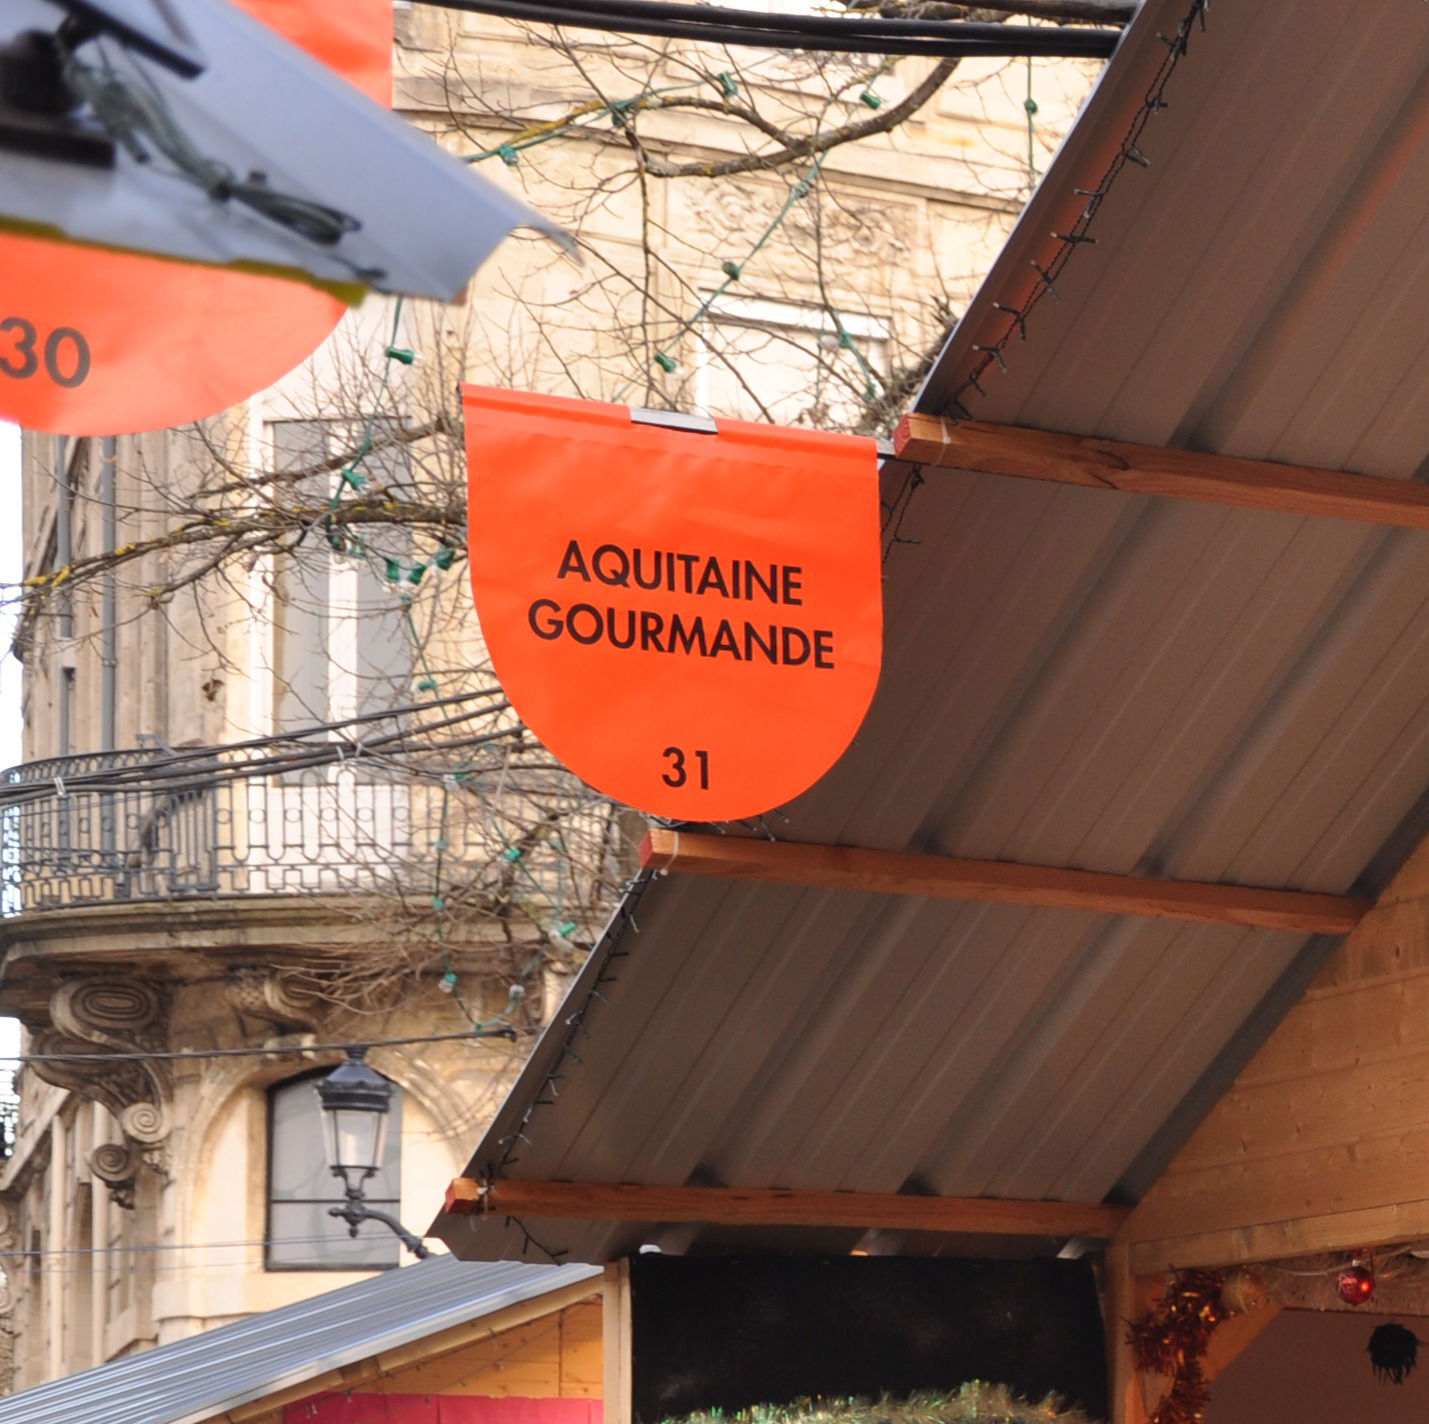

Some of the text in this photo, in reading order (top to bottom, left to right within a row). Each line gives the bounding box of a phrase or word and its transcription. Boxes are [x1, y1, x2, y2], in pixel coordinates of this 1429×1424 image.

[0, 317, 90, 388] 30
[556, 540, 804, 607] AQUITAINE
[528, 599, 836, 670] GOURMANDE
[660, 747, 711, 791] 31
